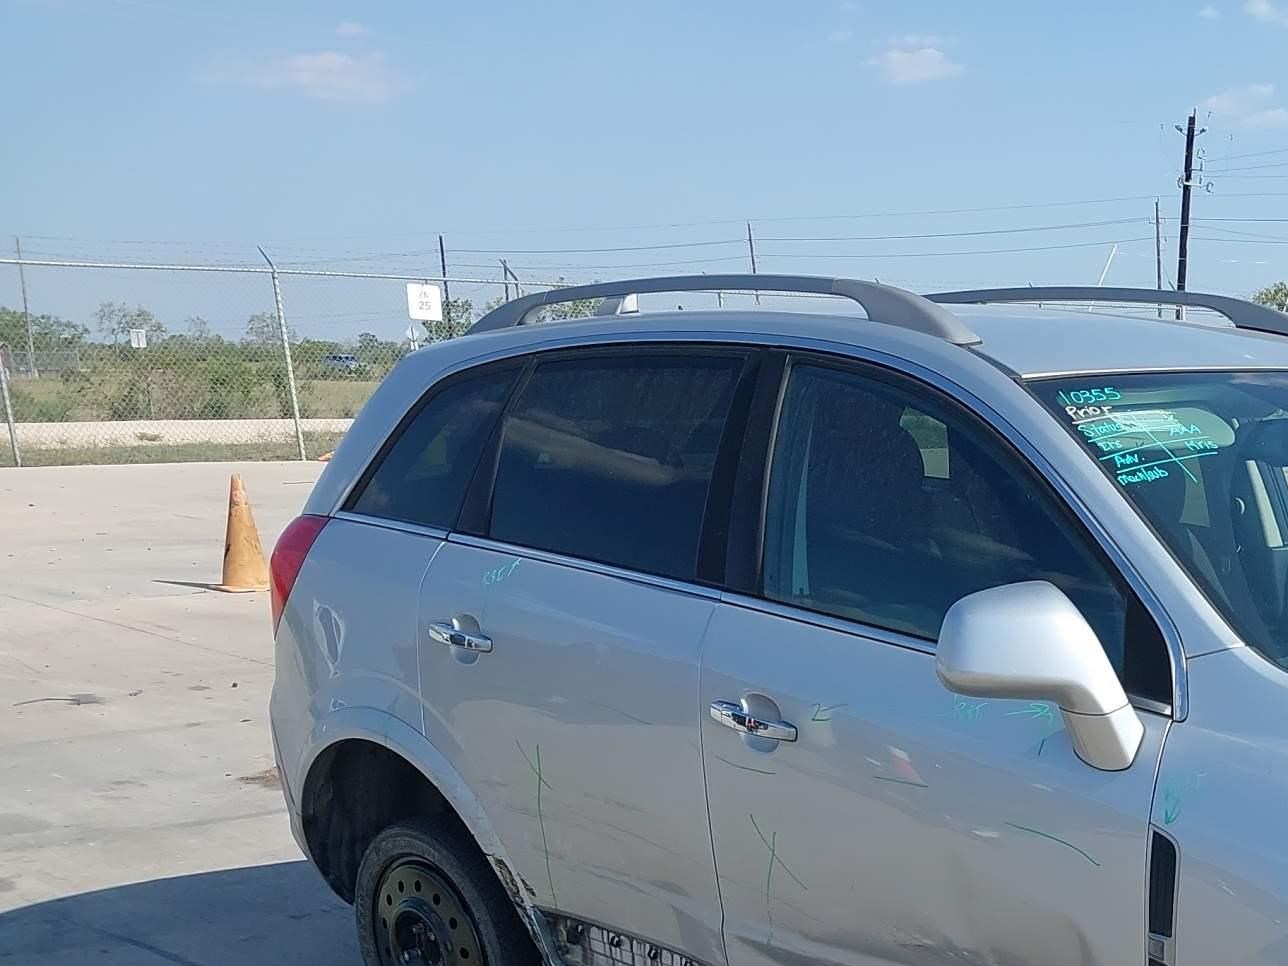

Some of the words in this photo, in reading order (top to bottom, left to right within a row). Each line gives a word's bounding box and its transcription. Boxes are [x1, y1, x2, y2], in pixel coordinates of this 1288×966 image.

[418, 301, 431, 311] 25
[1058, 387, 1121, 405] 10355
[1065, 405, 1113, 420] Prior
